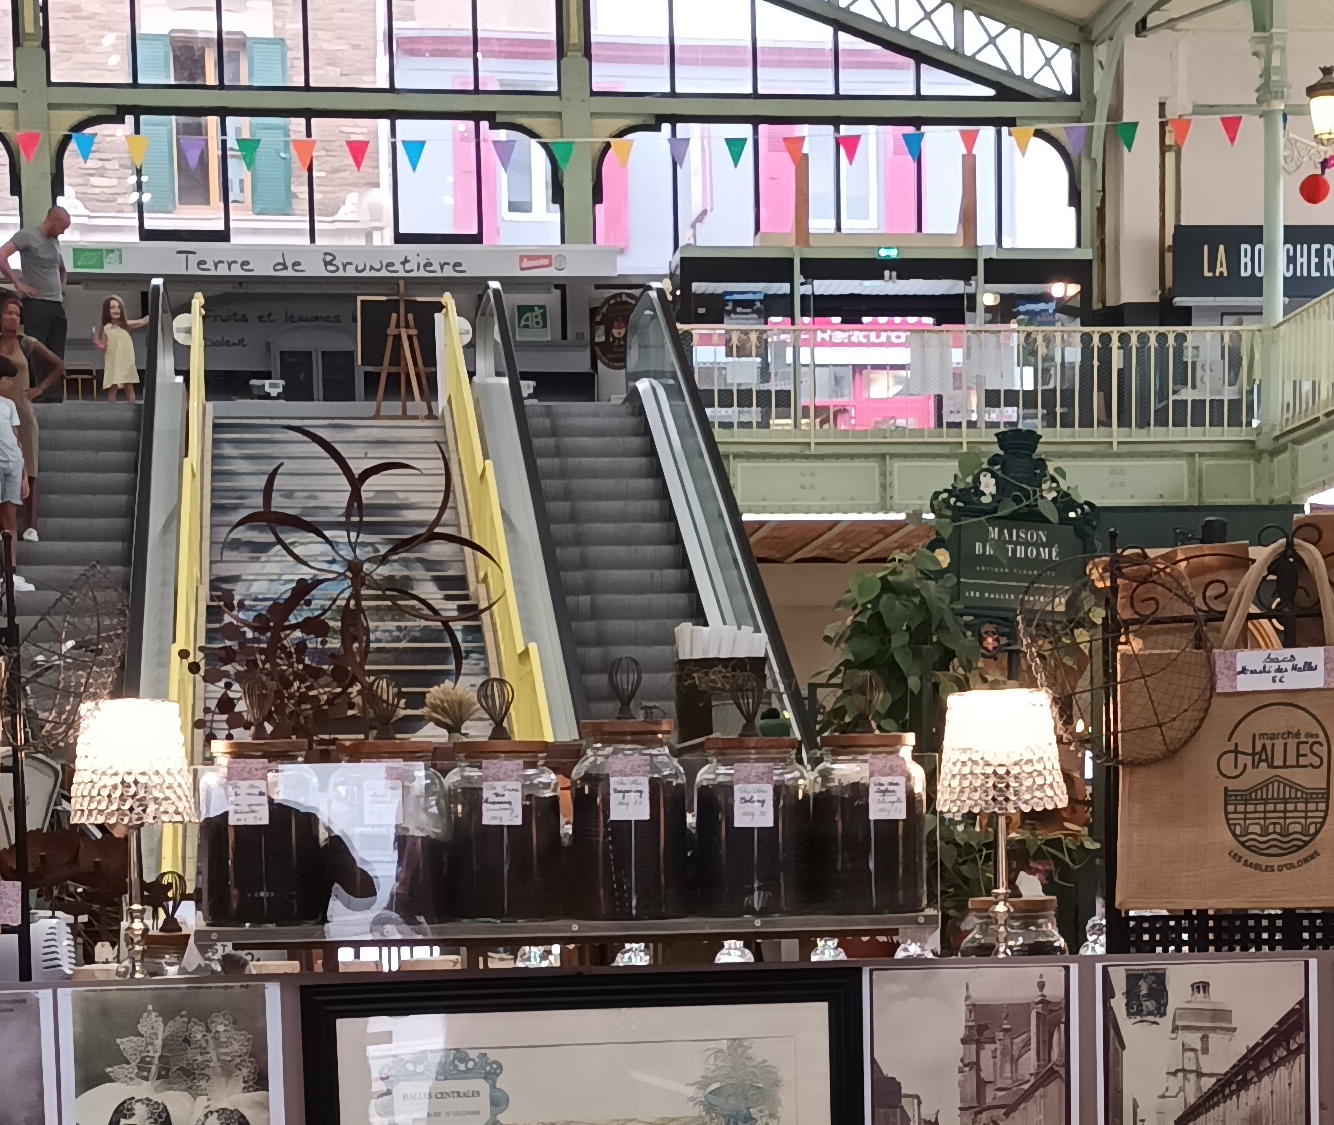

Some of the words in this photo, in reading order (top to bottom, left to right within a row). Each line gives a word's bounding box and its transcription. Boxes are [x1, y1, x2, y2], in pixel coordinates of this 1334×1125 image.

[175, 250, 255, 274] Terre
[272, 252, 306, 274] de
[1203, 243, 1228, 277] LA
[988, 526, 1048, 544] MAISON
[975, 540, 1060, 561] BRTHOMÉ
[1258, 729, 1302, 741] marché
[1303, 731, 1320, 740] des
[1217, 733, 1324, 780] HALLES
[1227, 849, 1242, 864] LES
[1242, 858, 1276, 873] SABLES
[434, 1090, 481, 1099] CENTRALES
